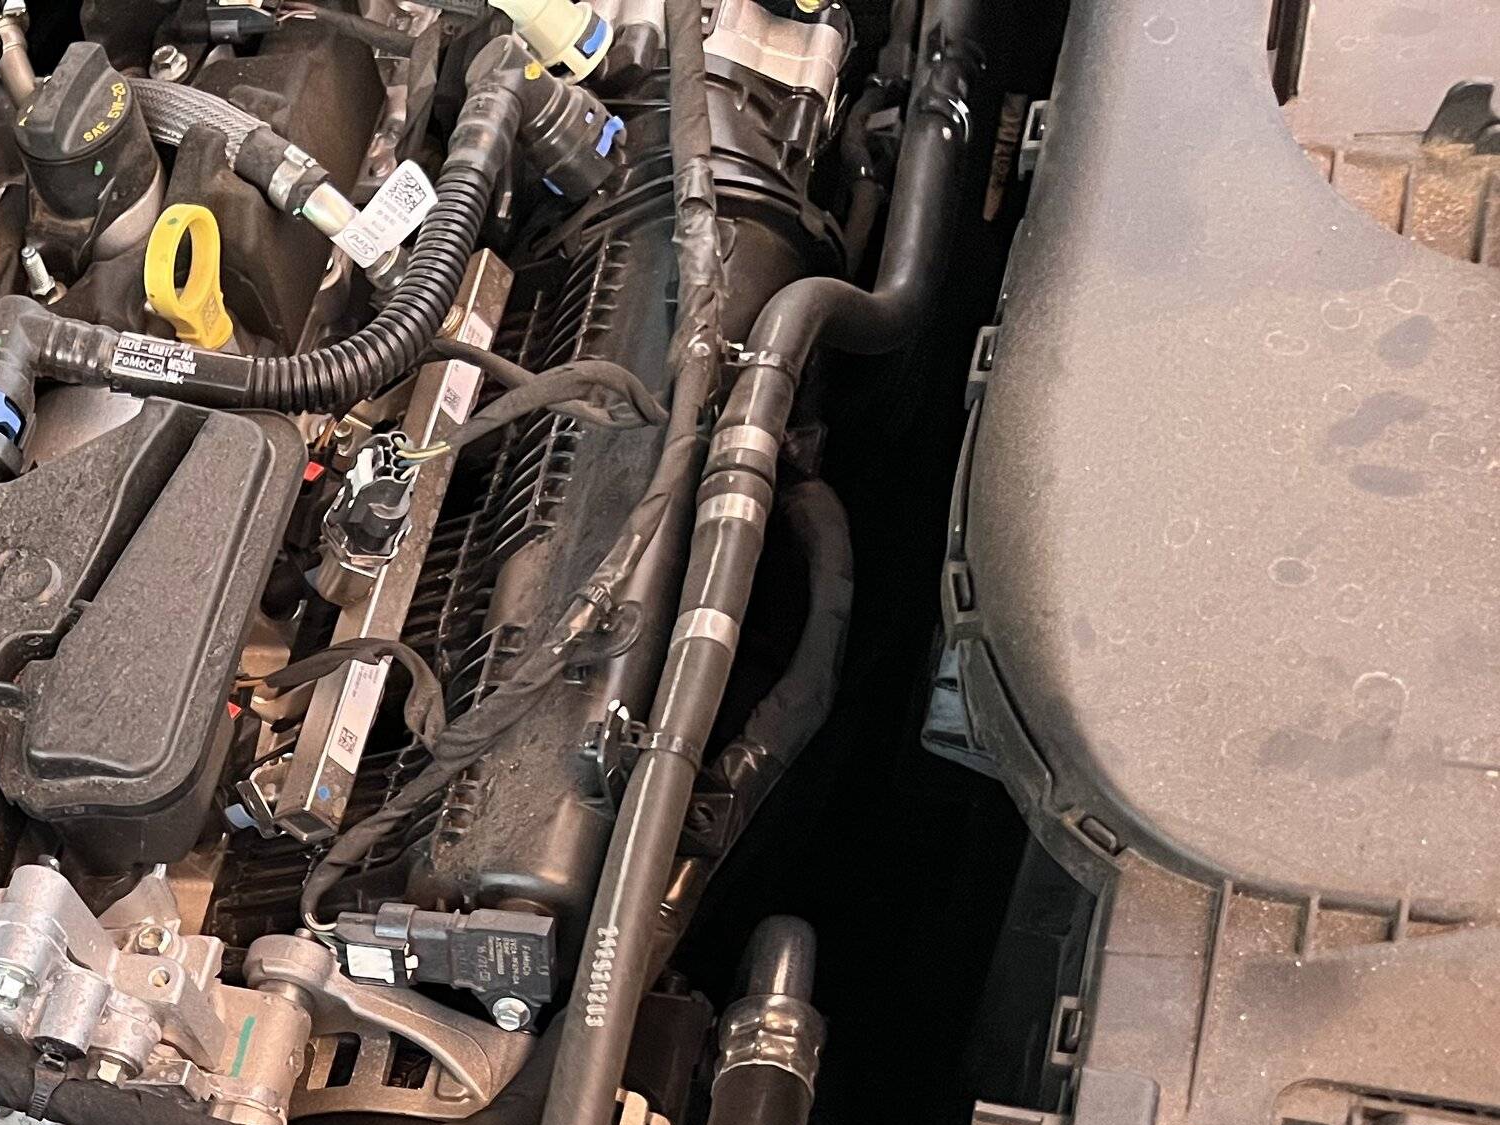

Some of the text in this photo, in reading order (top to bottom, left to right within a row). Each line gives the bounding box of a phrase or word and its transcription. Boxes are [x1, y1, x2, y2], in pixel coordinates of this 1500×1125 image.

[83, 121, 110, 142] SAE
[114, 351, 161, 373] FoMoCo
[522, 944, 532, 976] FoMoCo
